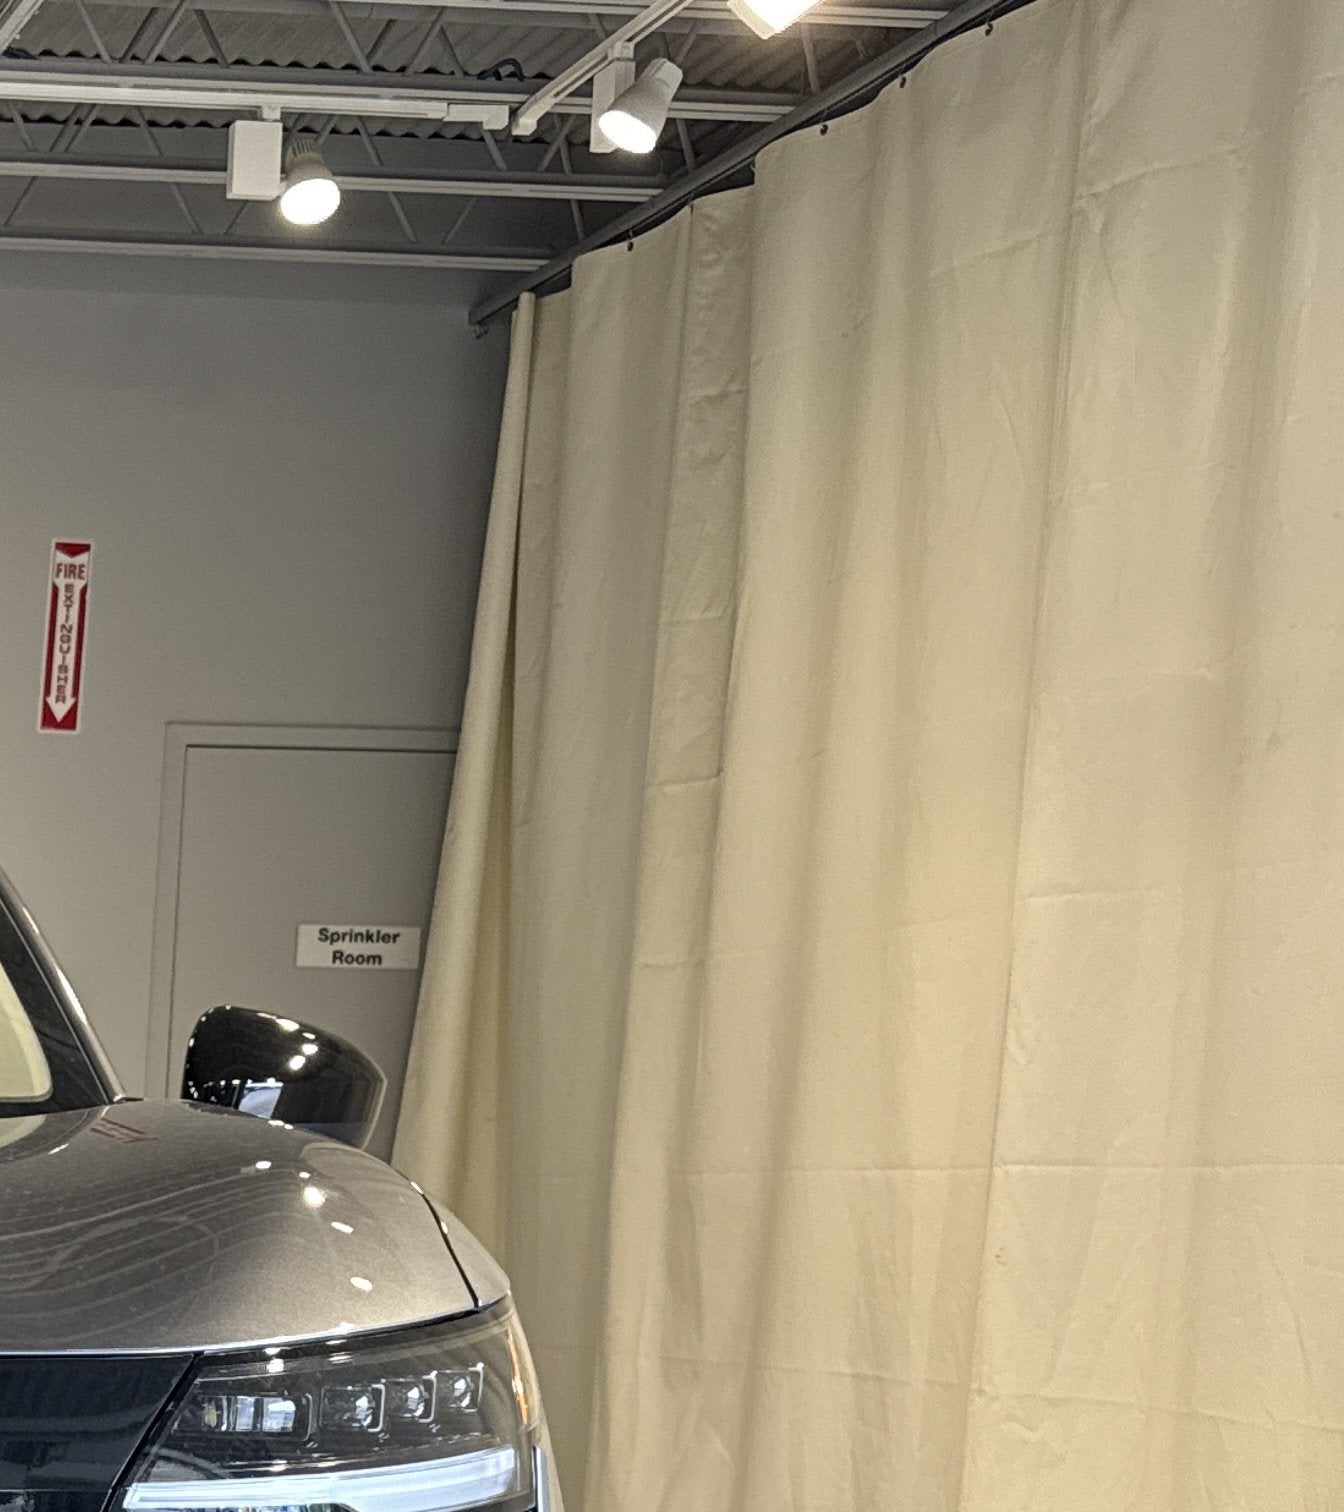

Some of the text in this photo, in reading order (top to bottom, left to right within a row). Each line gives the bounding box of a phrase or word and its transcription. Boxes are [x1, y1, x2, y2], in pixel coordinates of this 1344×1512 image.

[55, 563, 86, 580] FIRE
[56, 584, 75, 704] EXTINGUISHER
[318, 927, 400, 945] Sprinkler
[332, 950, 383, 966] Room
